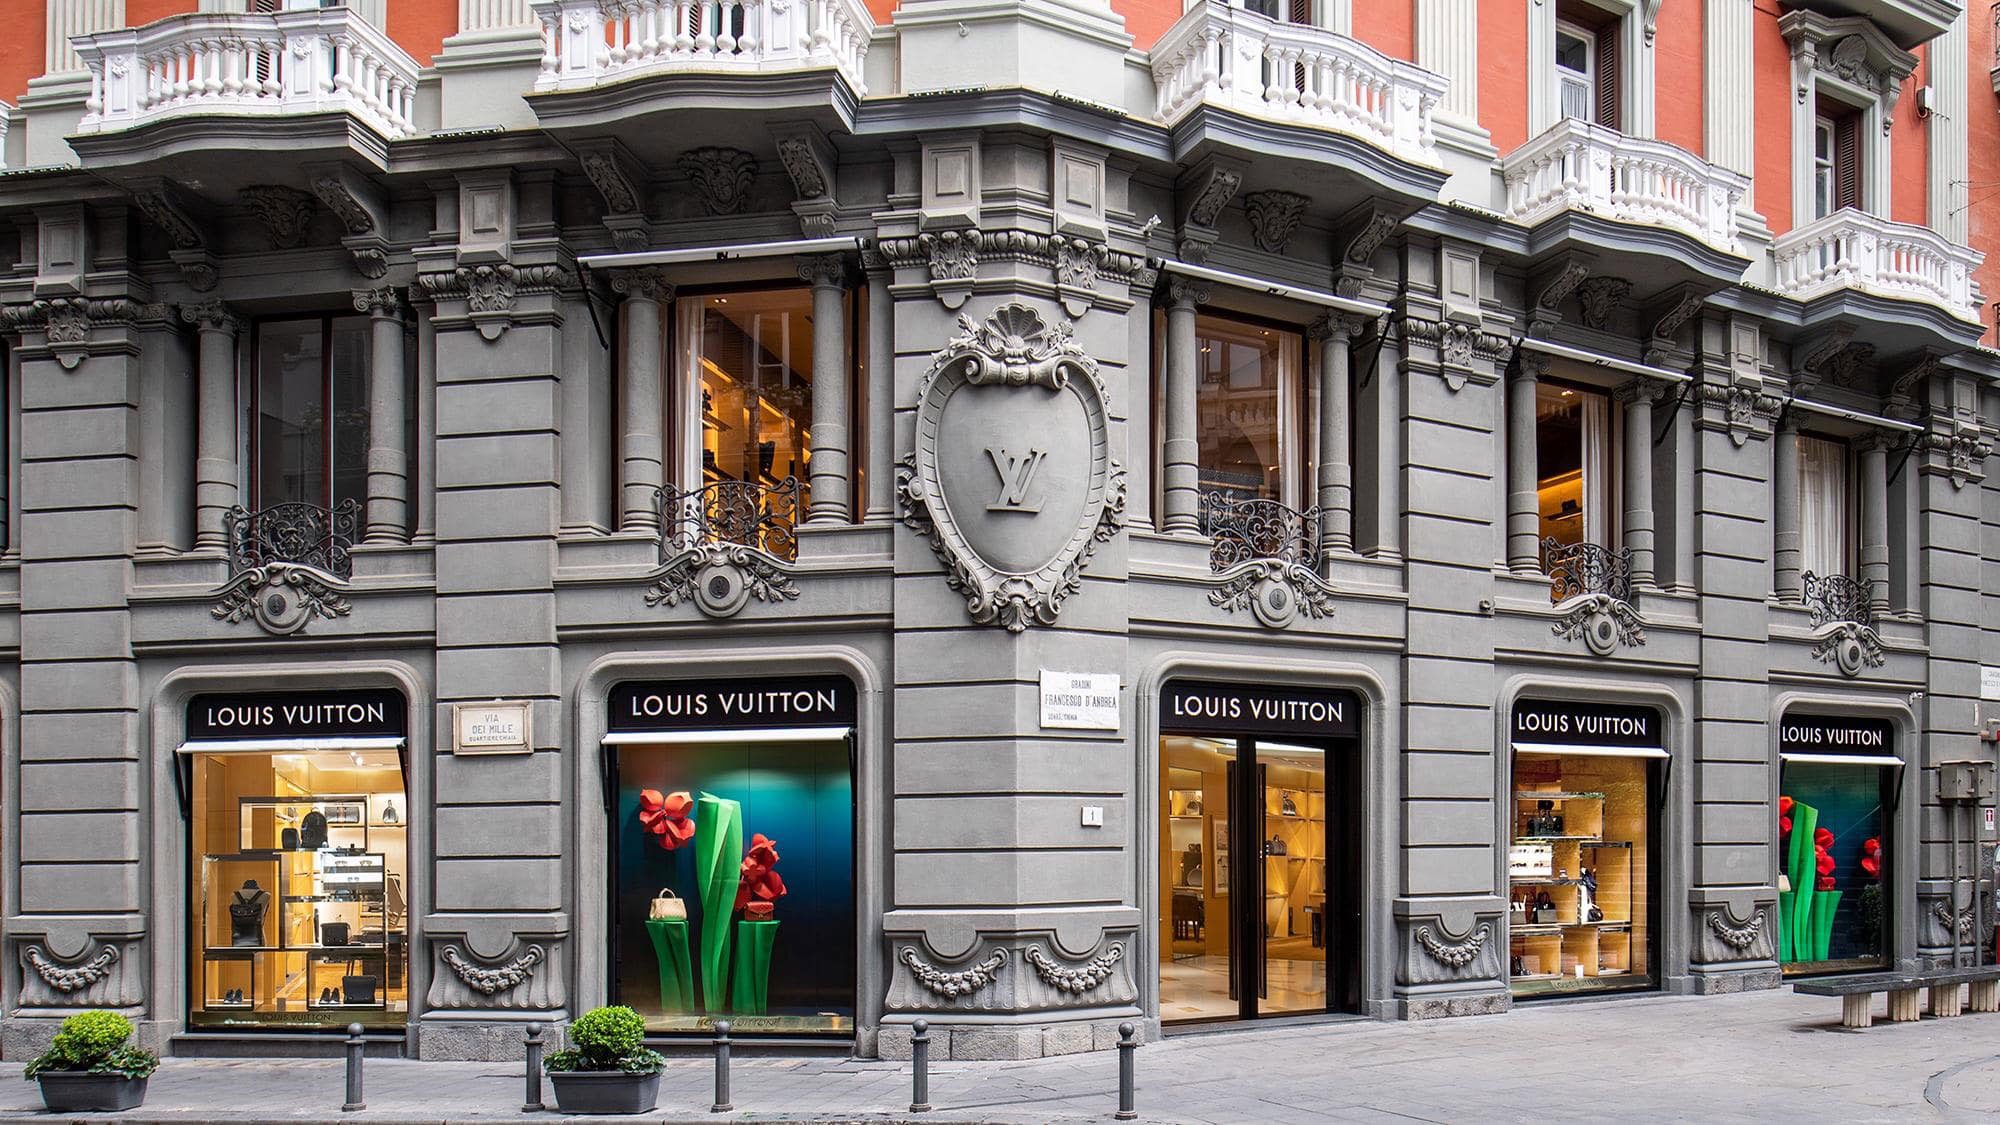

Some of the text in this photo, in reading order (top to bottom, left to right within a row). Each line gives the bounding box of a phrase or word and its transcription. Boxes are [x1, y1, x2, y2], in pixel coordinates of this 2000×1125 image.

[632, 689, 836, 716] LOUIS VUITTON
[1045, 694, 1117, 708] FRANCESCO D'ANDREA
[1174, 695, 1344, 723] LOUIS VUITTON
[207, 702, 384, 726] LOUIS VUITTON
[485, 714, 499, 723] VIA
[1518, 712, 1647, 736] LOUIS VUITTON
[472, 724, 513, 735] DEI MILLE
[1782, 726, 1883, 746] LOUIS VUITTON
[290, 1013, 331, 1021] VUITTON
